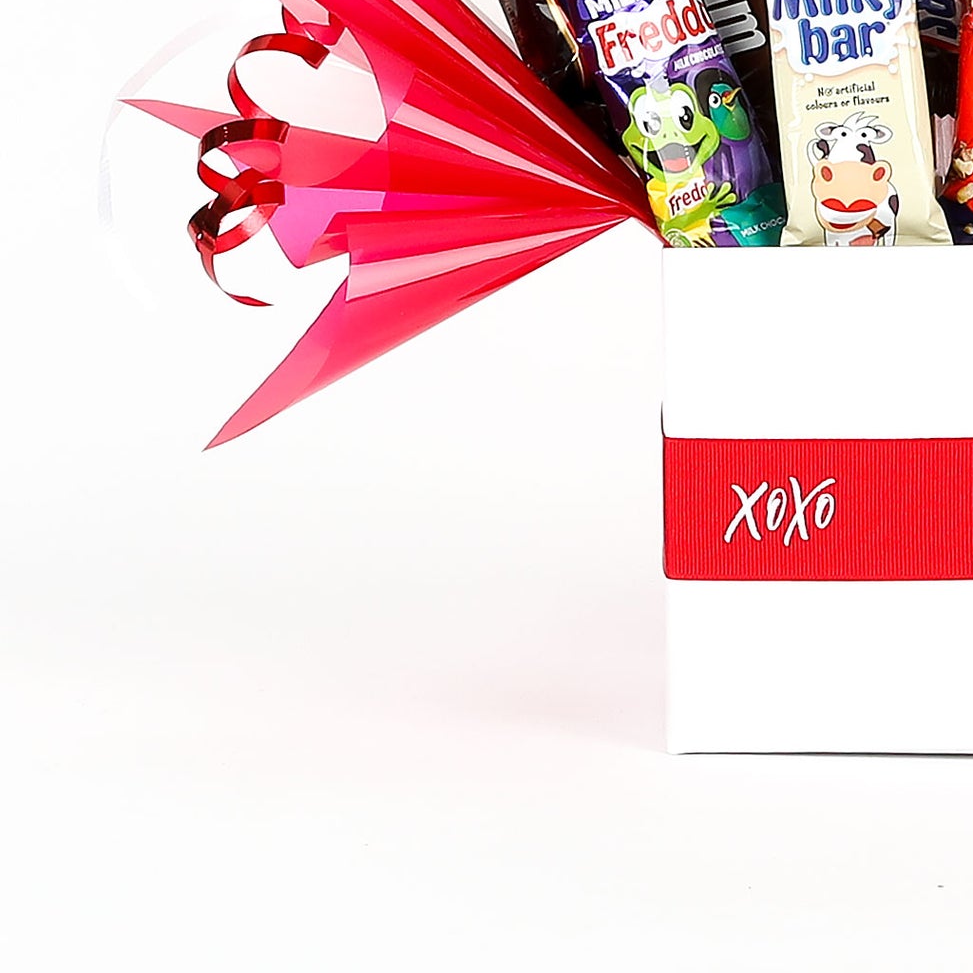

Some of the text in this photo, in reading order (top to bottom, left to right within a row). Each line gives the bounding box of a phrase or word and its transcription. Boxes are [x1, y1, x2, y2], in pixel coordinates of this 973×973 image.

[798, 18, 886, 66] bar
[835, 80, 876, 95] artificial
[805, 95, 891, 111] colours or flavours
